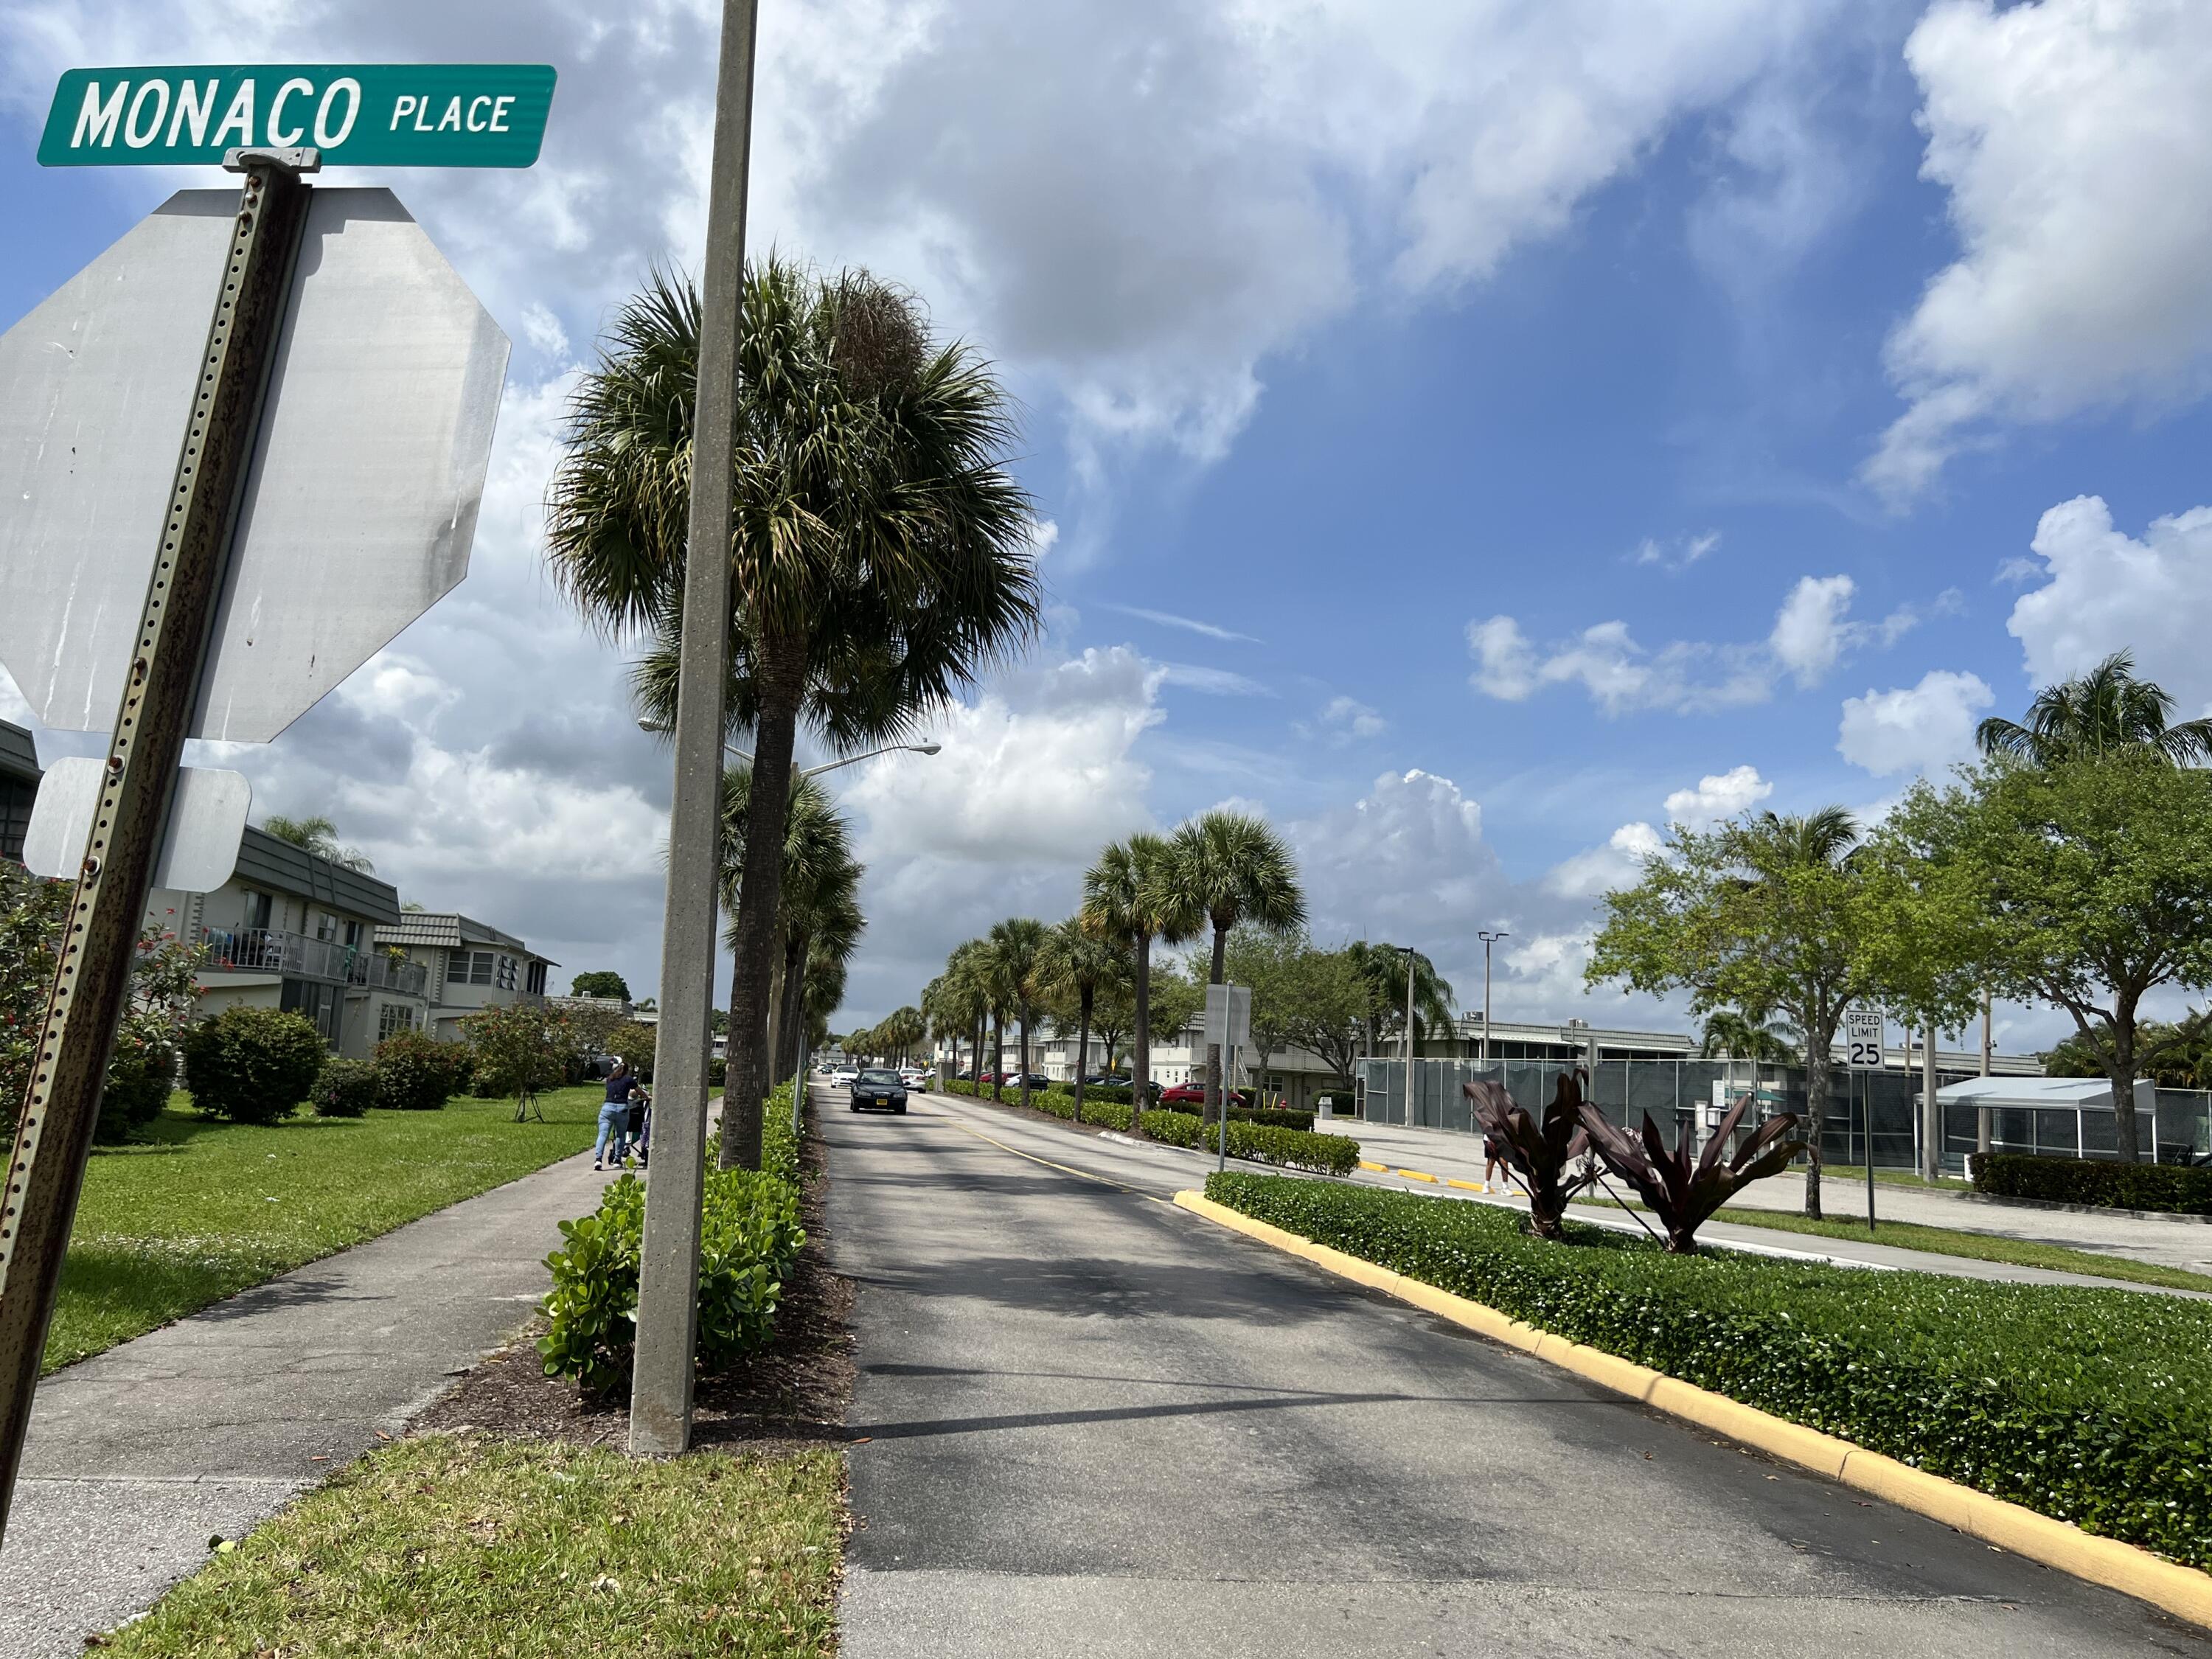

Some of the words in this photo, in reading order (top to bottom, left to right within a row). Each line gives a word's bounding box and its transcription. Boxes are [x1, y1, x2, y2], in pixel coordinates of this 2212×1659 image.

[71, 77, 361, 149] MONACO
[389, 95, 515, 133] PLACE
[1848, 1015, 1880, 1026] SPEED
[1851, 1027, 1878, 1037] LIMIT
[1851, 1043, 1879, 1065] 25
